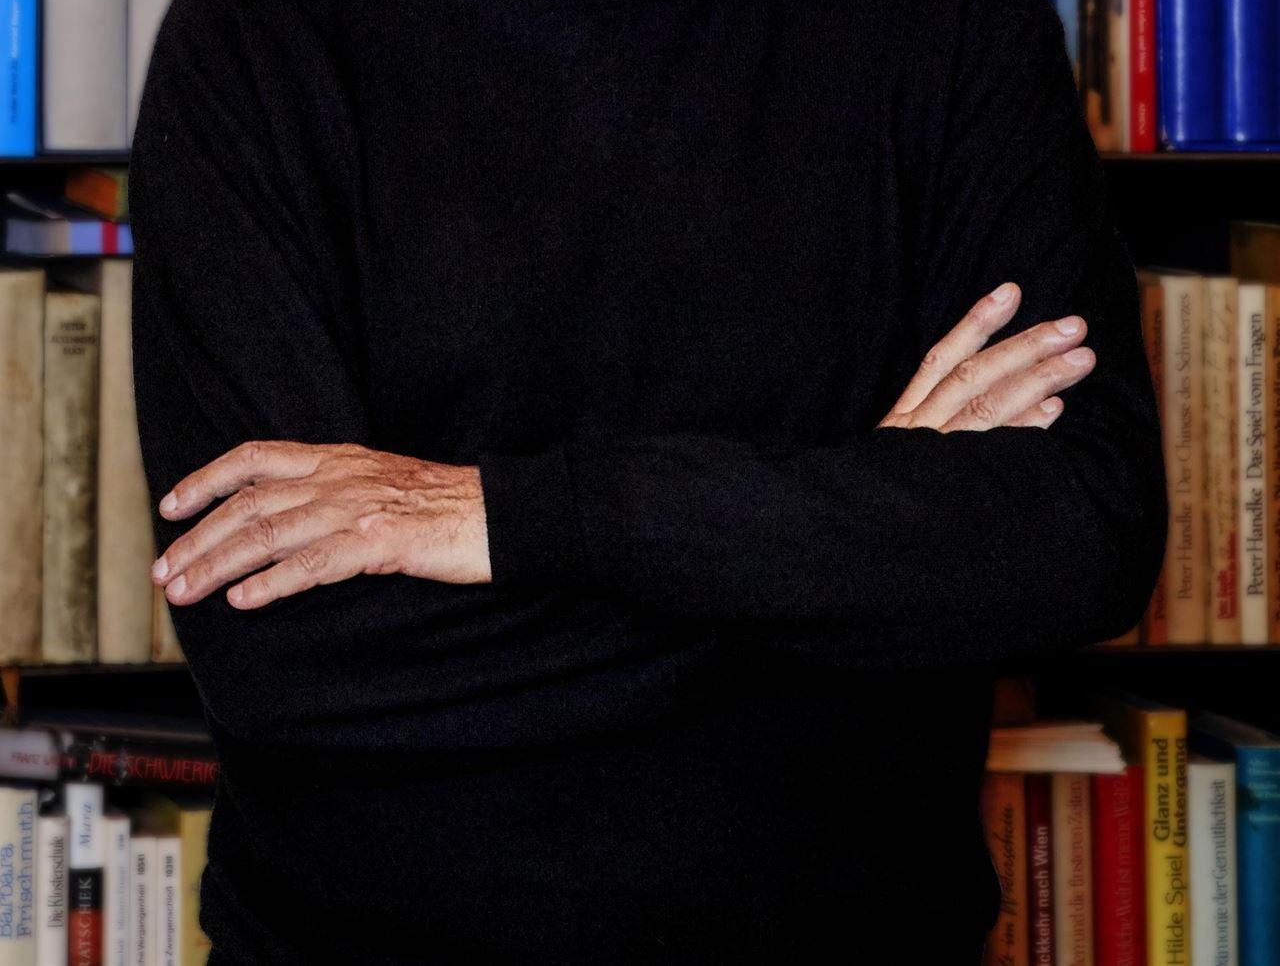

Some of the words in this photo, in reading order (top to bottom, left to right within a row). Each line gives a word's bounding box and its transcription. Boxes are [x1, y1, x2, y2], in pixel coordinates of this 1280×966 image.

[1246, 313, 1265, 368] Fragen
[1245, 409, 1265, 447] Spiel
[1246, 448, 1263, 479] Das
[1246, 487, 1264, 552] Handke
[1246, 555, 1264, 597] Peter
[1152, 737, 1169, 777] und
[1152, 783, 1169, 843] Glanz
[1033, 825, 1049, 867] Wien
[1035, 871, 1050, 908] nach
[1165, 856, 1187, 906] Spiel
[1166, 913, 1185, 966] Hilde
